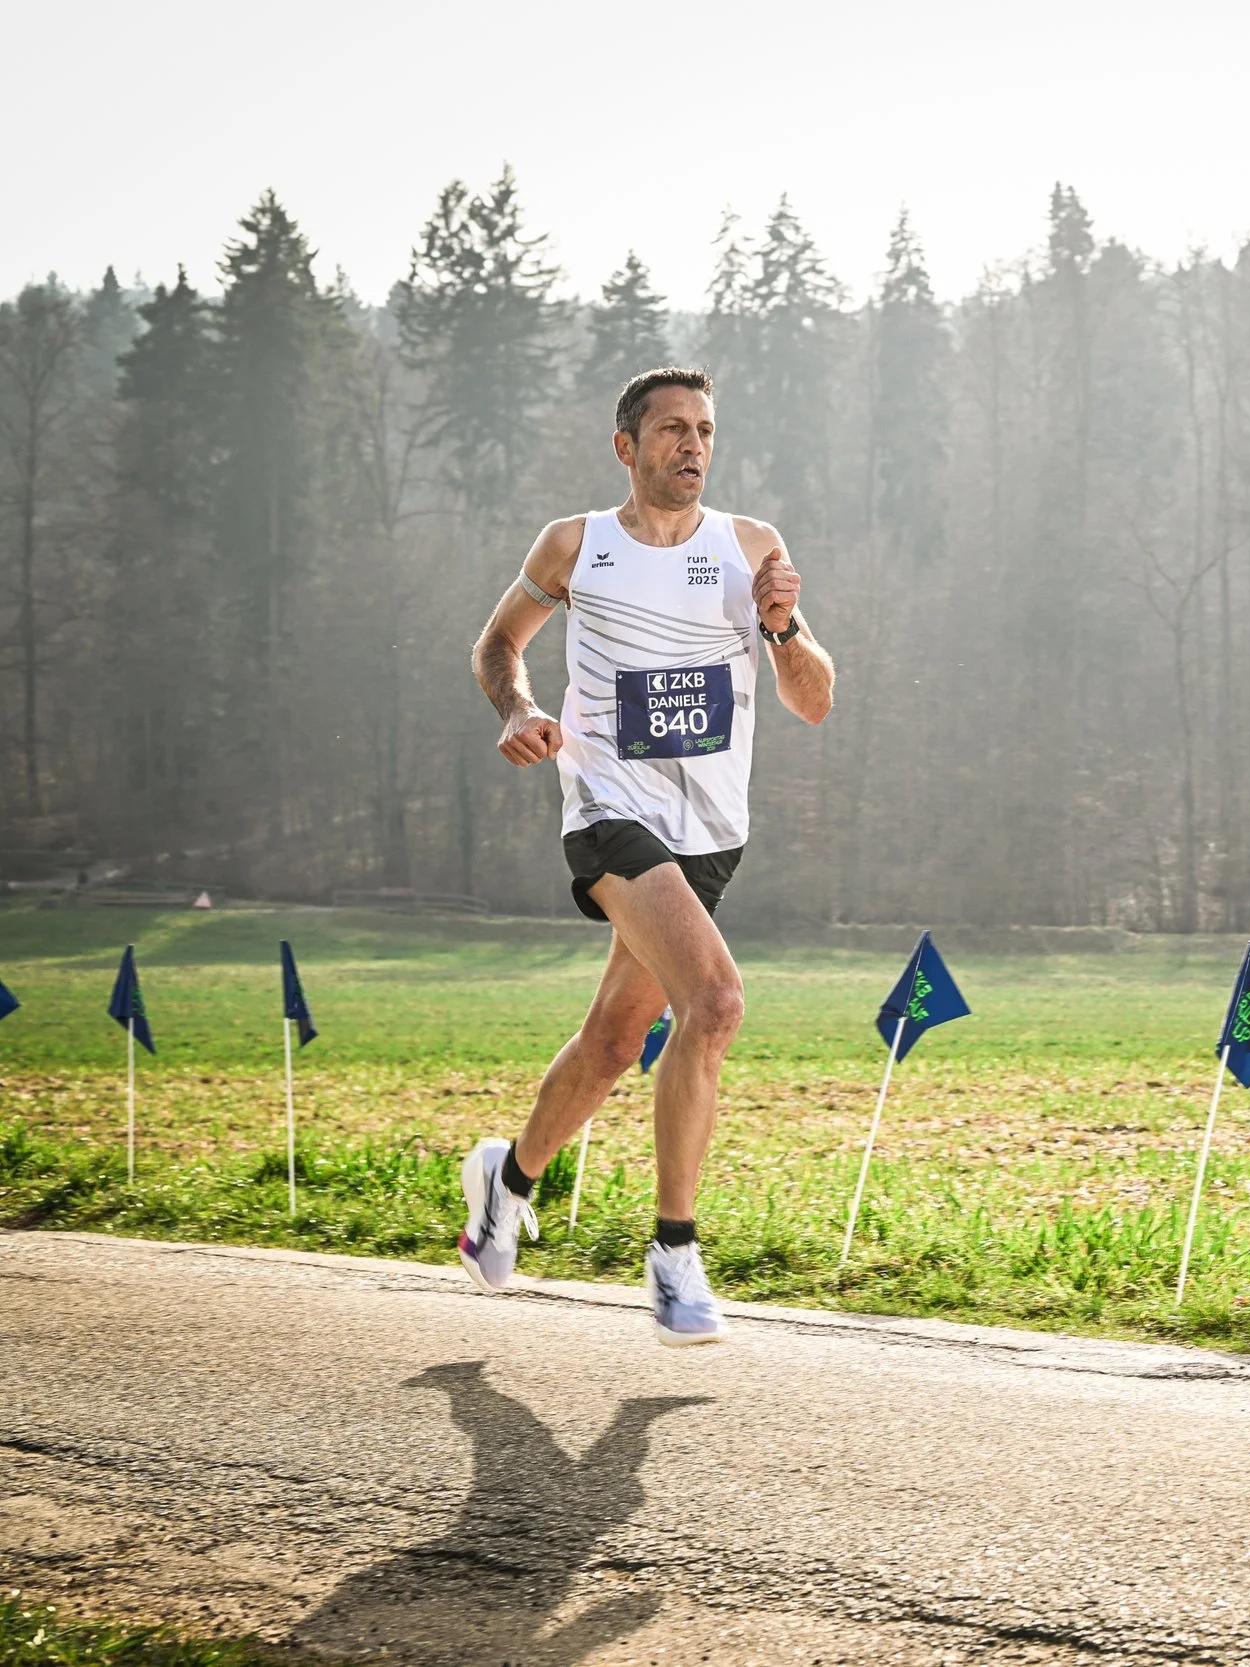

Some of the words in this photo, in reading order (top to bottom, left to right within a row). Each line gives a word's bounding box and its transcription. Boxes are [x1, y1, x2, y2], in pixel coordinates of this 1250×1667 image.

[591, 561, 615, 569] erima
[687, 566, 720, 574] more
[687, 575, 718, 585] 2025
[670, 672, 706, 690] ZKB
[648, 693, 707, 709] DANIELE
[650, 708, 708, 738] 840
